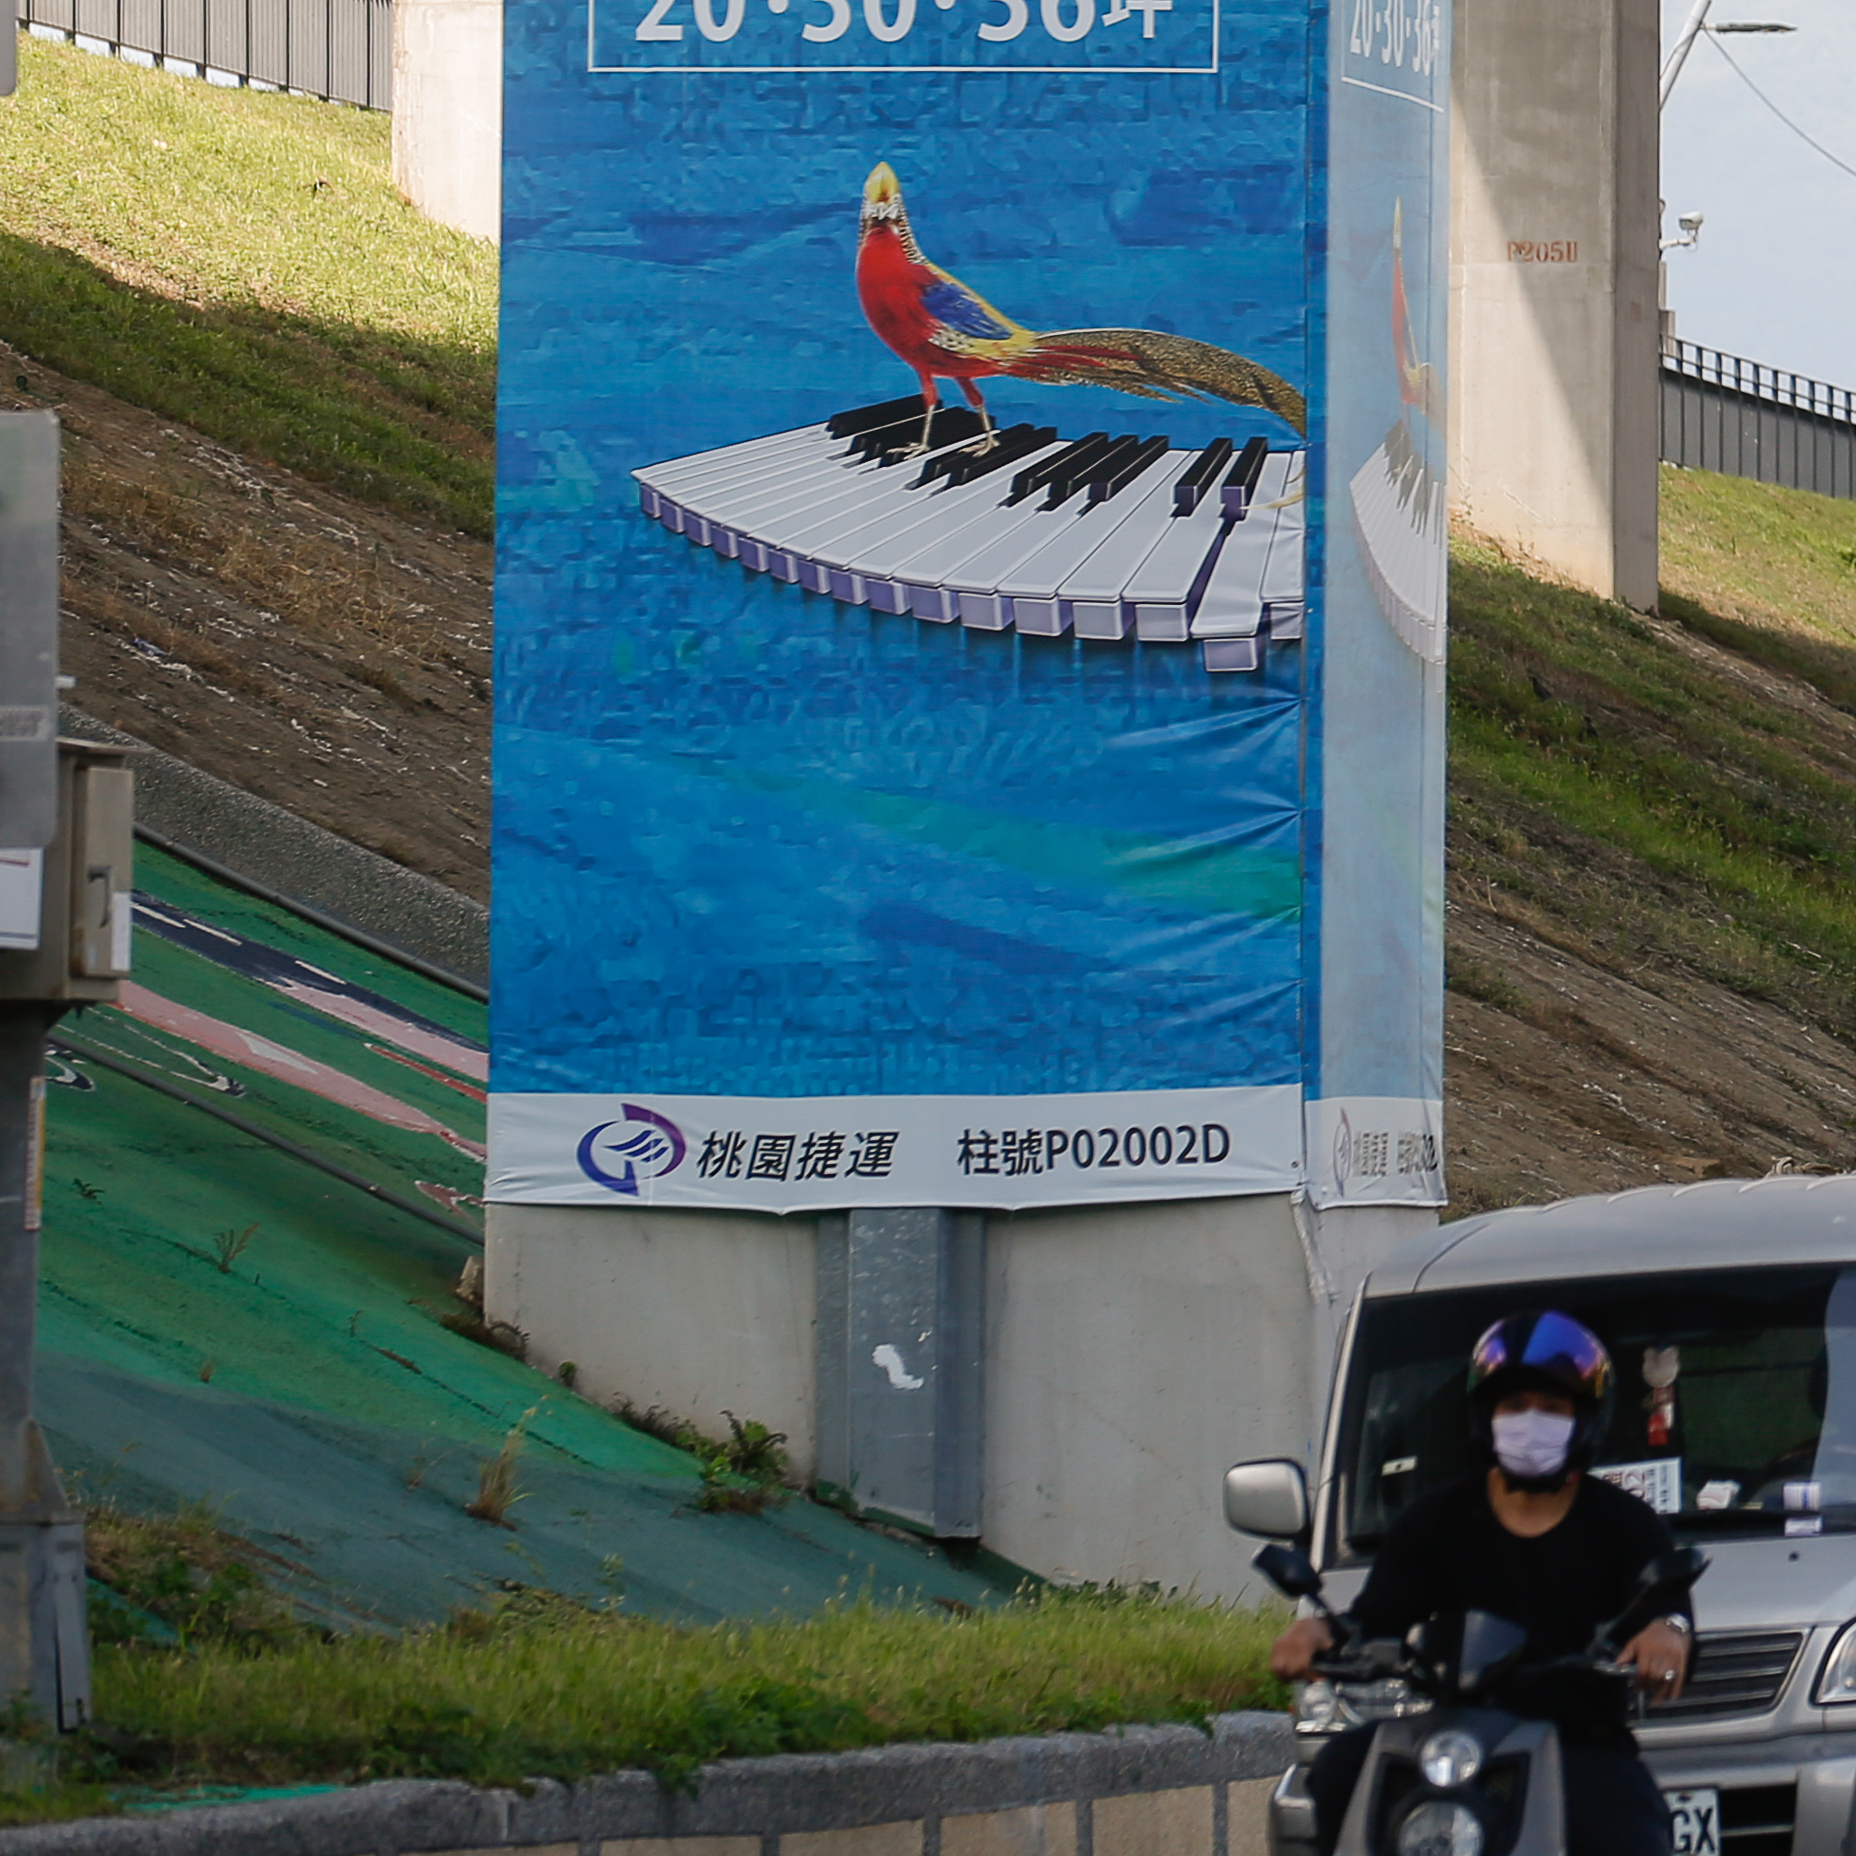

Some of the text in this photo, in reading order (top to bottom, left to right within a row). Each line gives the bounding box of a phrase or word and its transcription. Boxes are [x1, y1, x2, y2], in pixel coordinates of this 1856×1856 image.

[696, 1123, 1232, 1183] 桃園捷運 柱號P02002D
